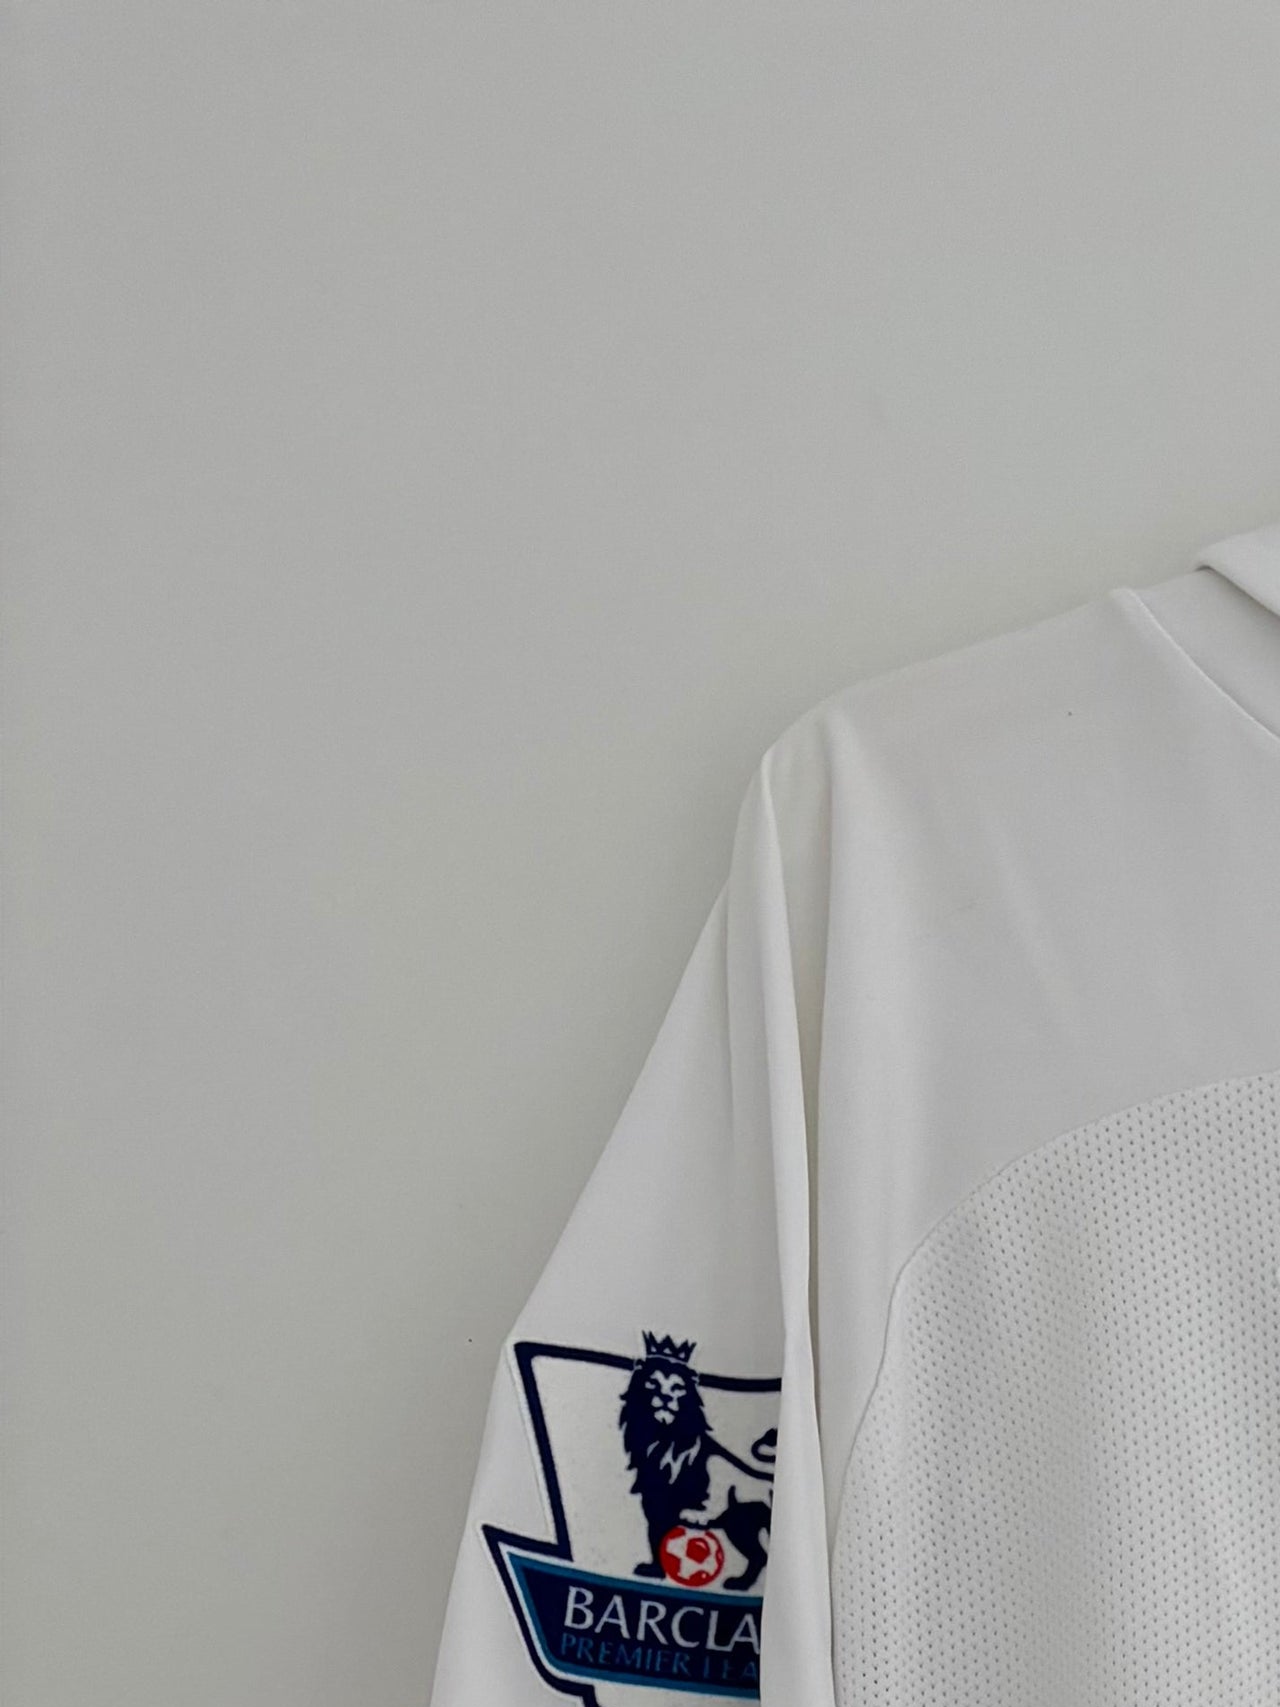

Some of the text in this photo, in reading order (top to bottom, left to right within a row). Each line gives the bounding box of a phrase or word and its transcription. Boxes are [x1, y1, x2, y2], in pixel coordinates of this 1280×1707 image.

[563, 1585, 761, 1655] BARCLA
[560, 1631, 760, 1682] PREMIER LEA
